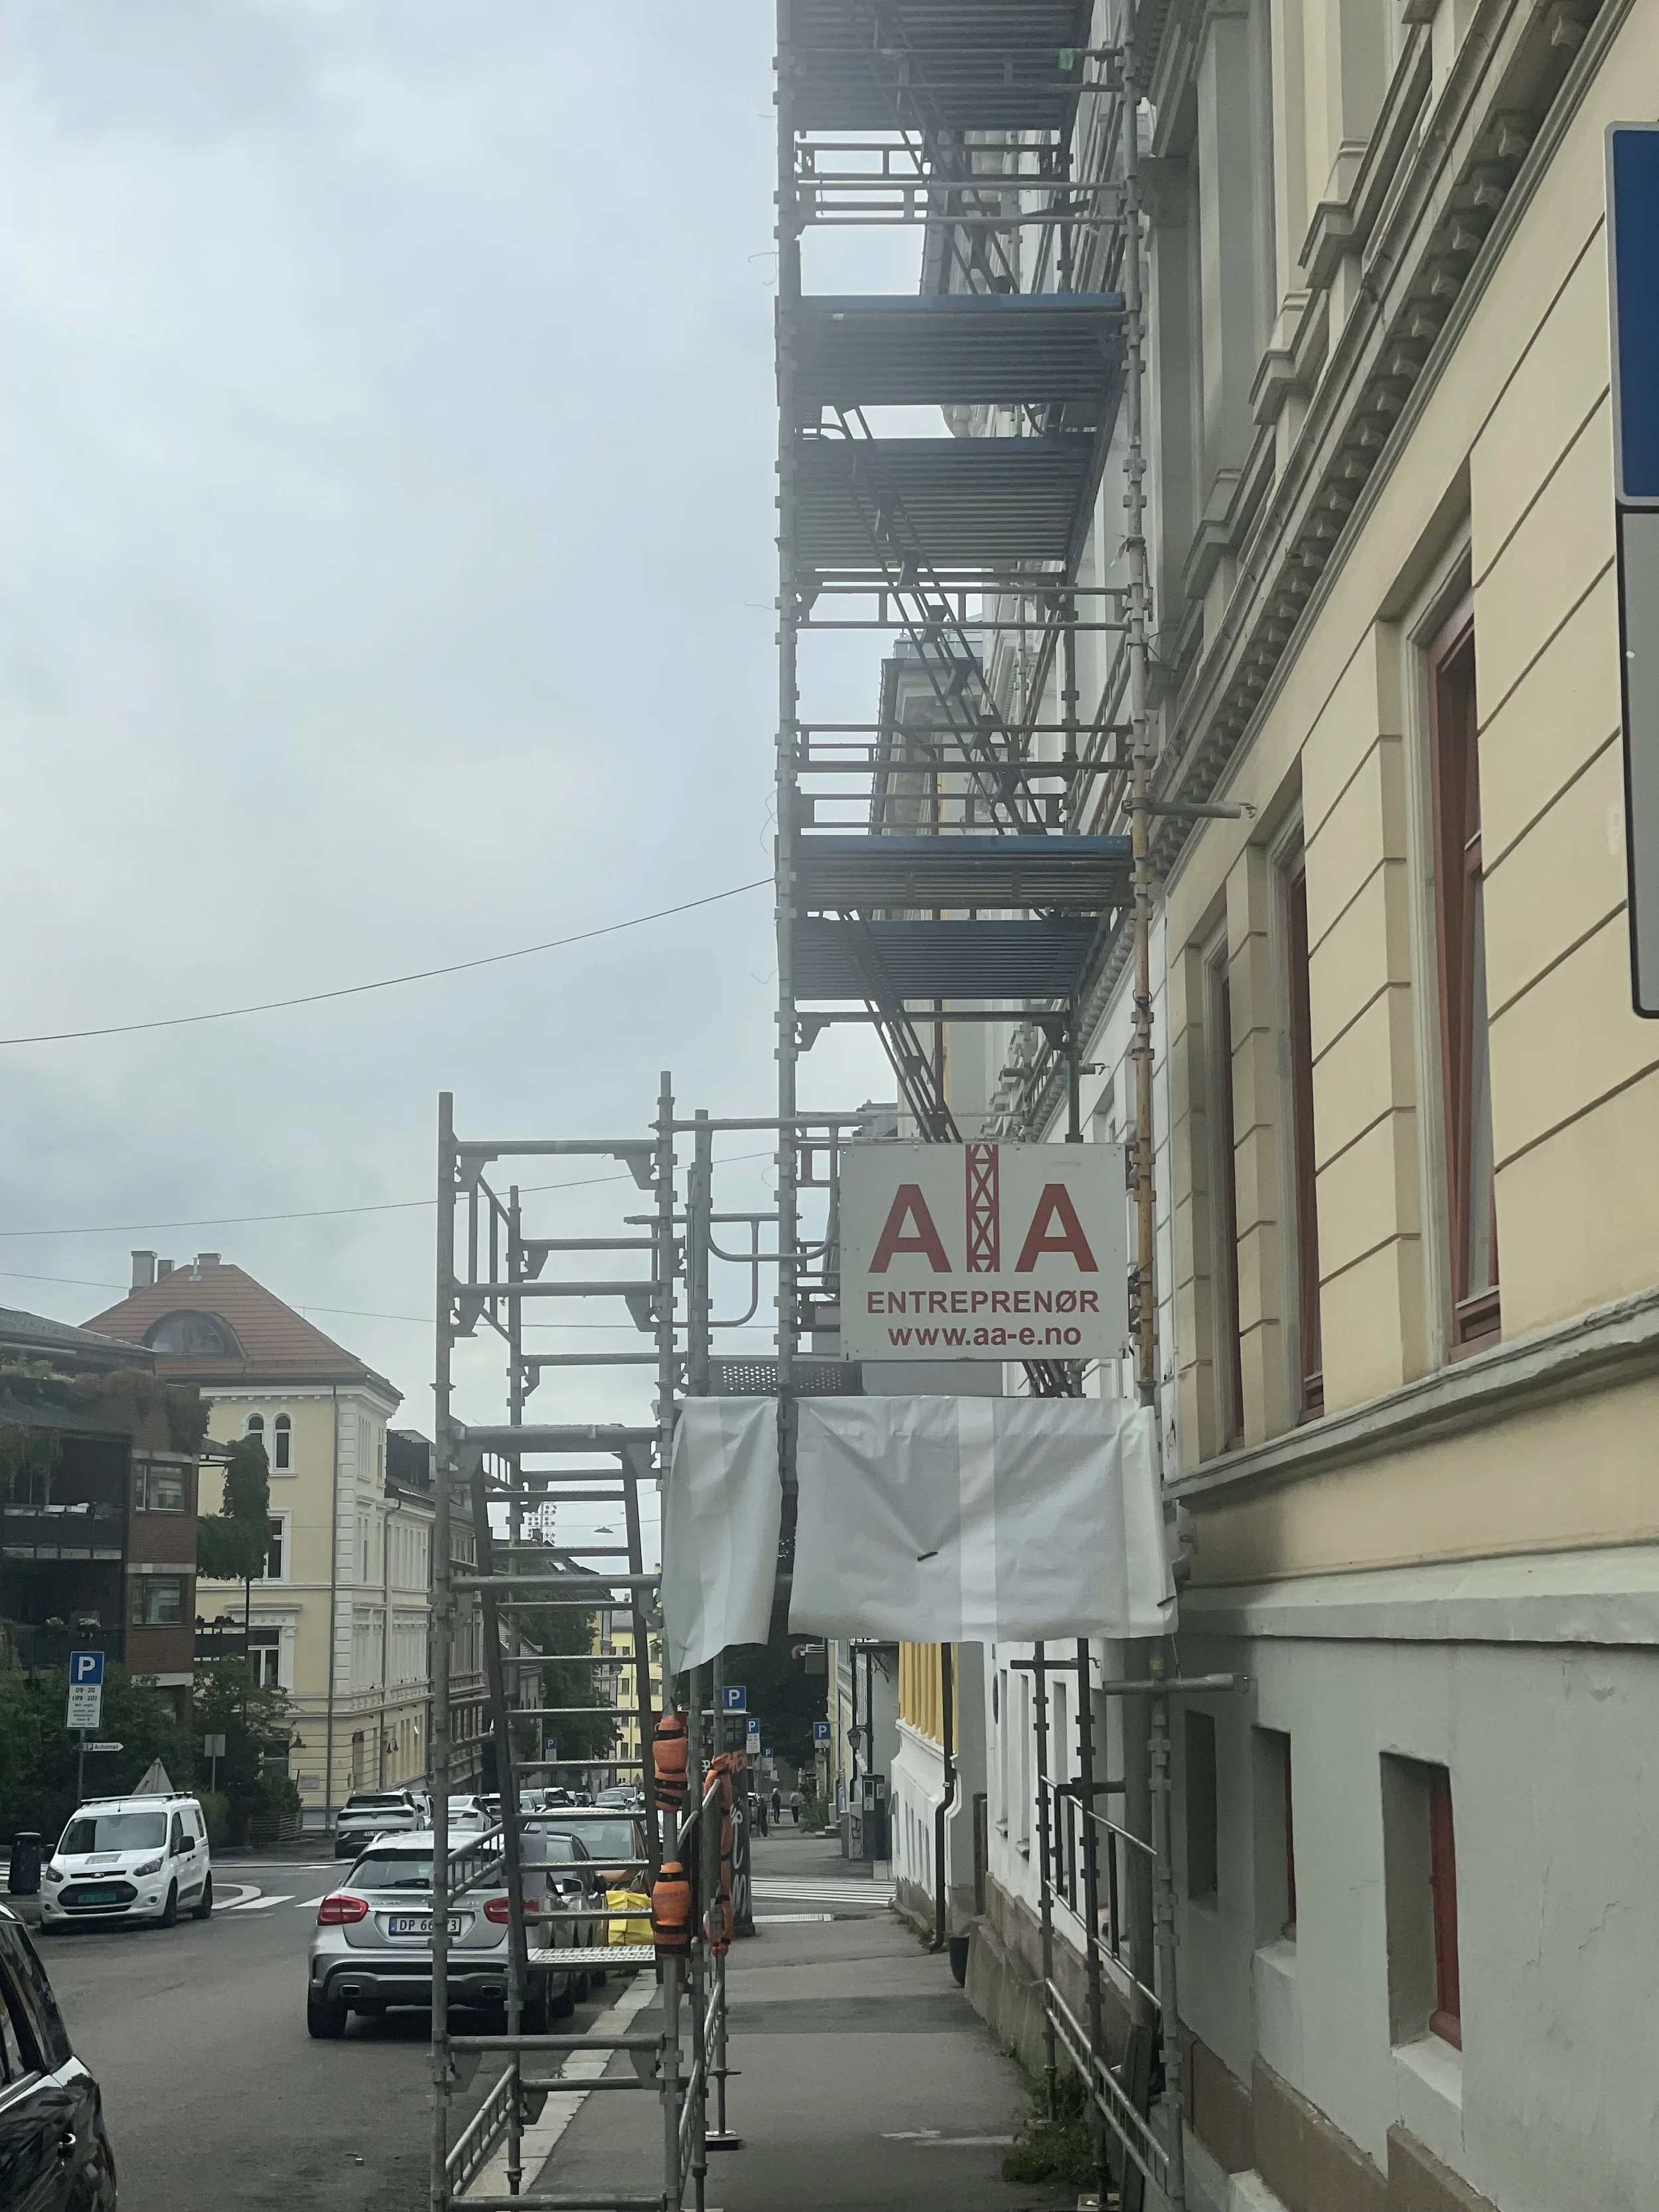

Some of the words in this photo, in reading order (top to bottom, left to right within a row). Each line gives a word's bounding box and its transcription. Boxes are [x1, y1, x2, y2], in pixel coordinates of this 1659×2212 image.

[867, 1290, 1100, 1314] ENTREPRENØR
[888, 1327, 1082, 1346] www.aa-e.no
[78, 1656, 96, 1680] P
[729, 1689, 741, 1707] P
[749, 1720, 756, 1732] P
[818, 1725, 827, 1738] P
[547, 1739, 553, 1748] P
[399, 1919, 415, 1931] DP
[420, 1919, 457, 1931] 663
